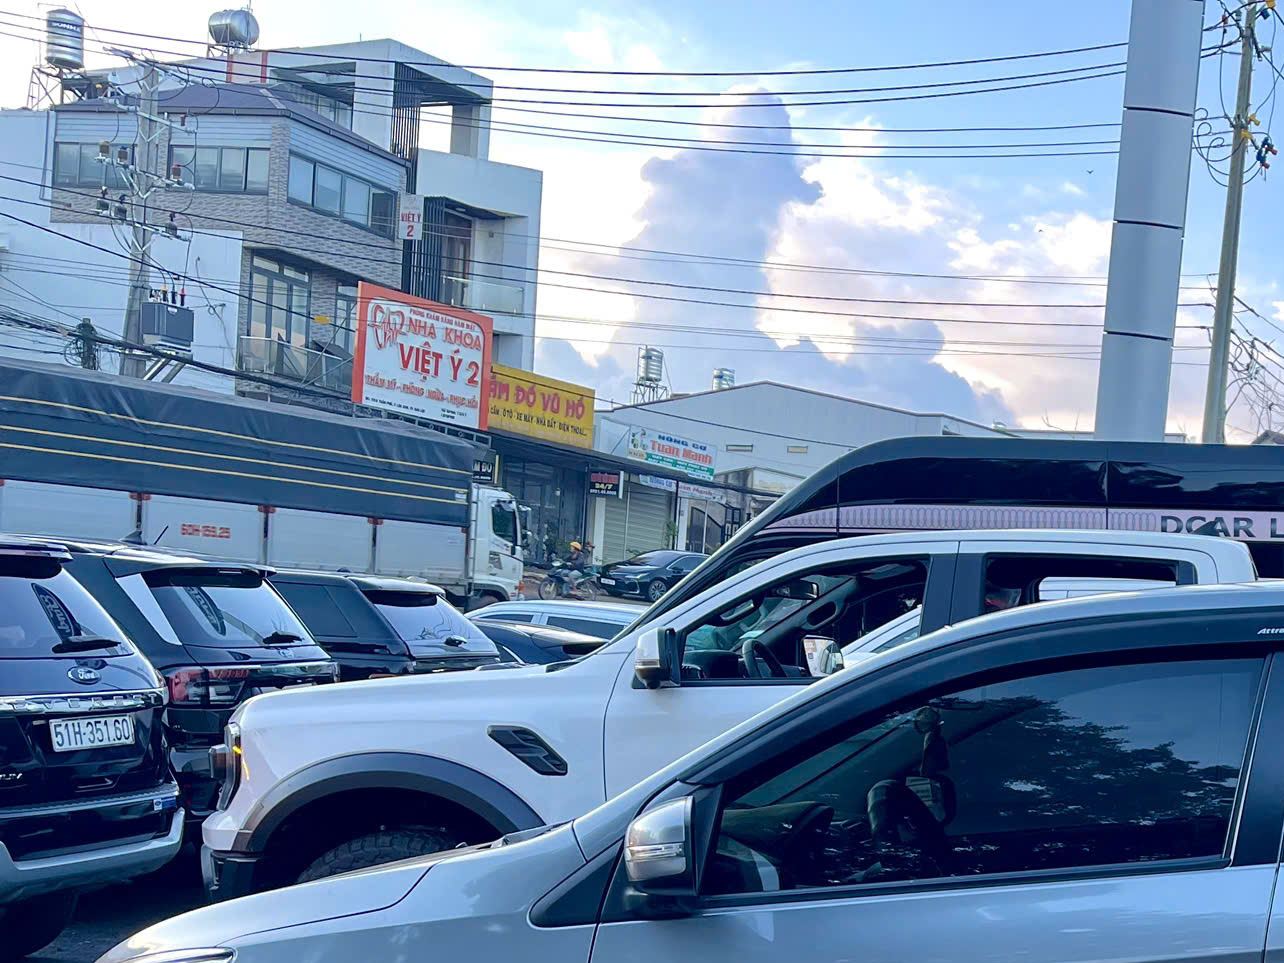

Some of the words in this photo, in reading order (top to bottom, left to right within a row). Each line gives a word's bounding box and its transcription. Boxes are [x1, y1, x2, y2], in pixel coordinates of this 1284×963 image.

[407, 225, 414, 237] 2
[408, 317, 437, 340] NHA
[444, 327, 481, 351] KHOA
[399, 341, 443, 381] VIỆT
[449, 349, 463, 382] Ý
[465, 361, 479, 386] 2
[1161, 515, 1256, 538] DCAR
[54, 717, 131, 748] 51H-351.60
